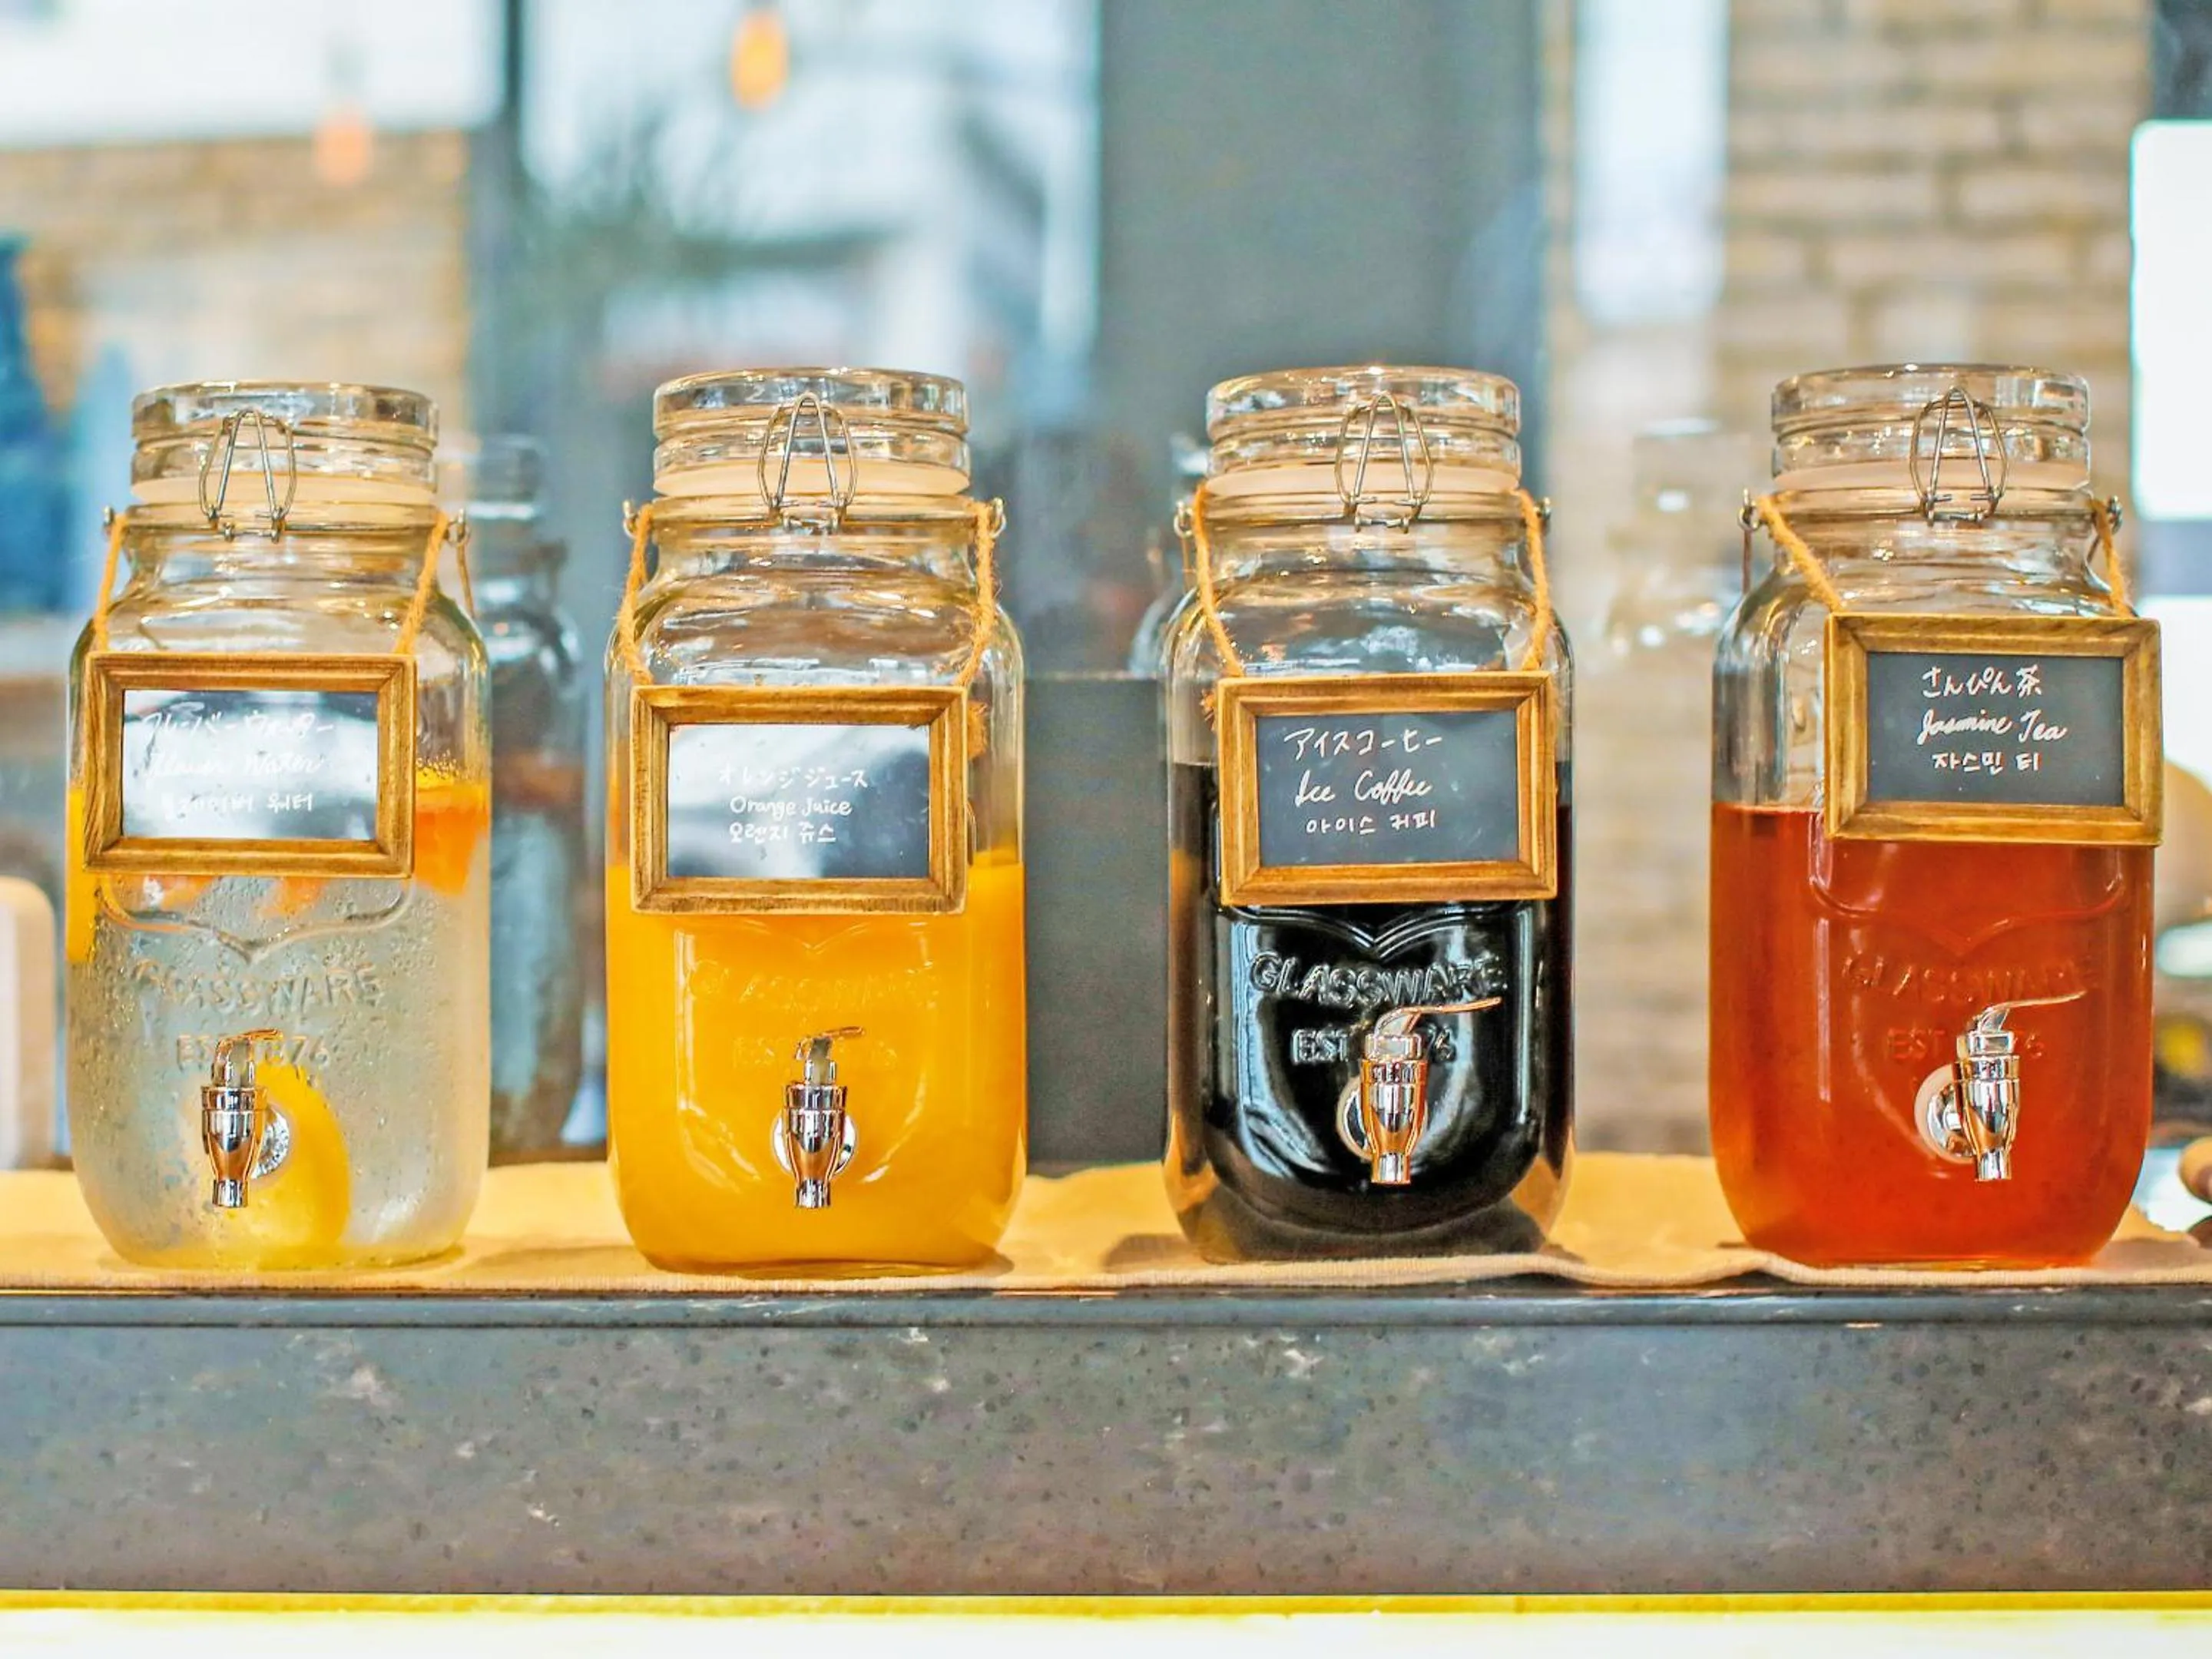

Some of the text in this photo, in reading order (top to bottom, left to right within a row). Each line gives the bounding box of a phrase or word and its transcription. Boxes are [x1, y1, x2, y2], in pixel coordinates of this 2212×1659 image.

[1922, 664, 2042, 698] さんぴん茶
[1916, 708, 2068, 746] Jasmine Tea
[1283, 728, 1442, 760] アイスコーヒー
[1932, 751, 2041, 777] 자스민 티
[267, 792, 313, 813] 워터
[1294, 768, 1432, 807] Ice Coffee
[730, 796, 853, 821] Orange Juice
[1306, 809, 1435, 835] 아이스 커피
[1250, 950, 1508, 1008] GLASSWARE
